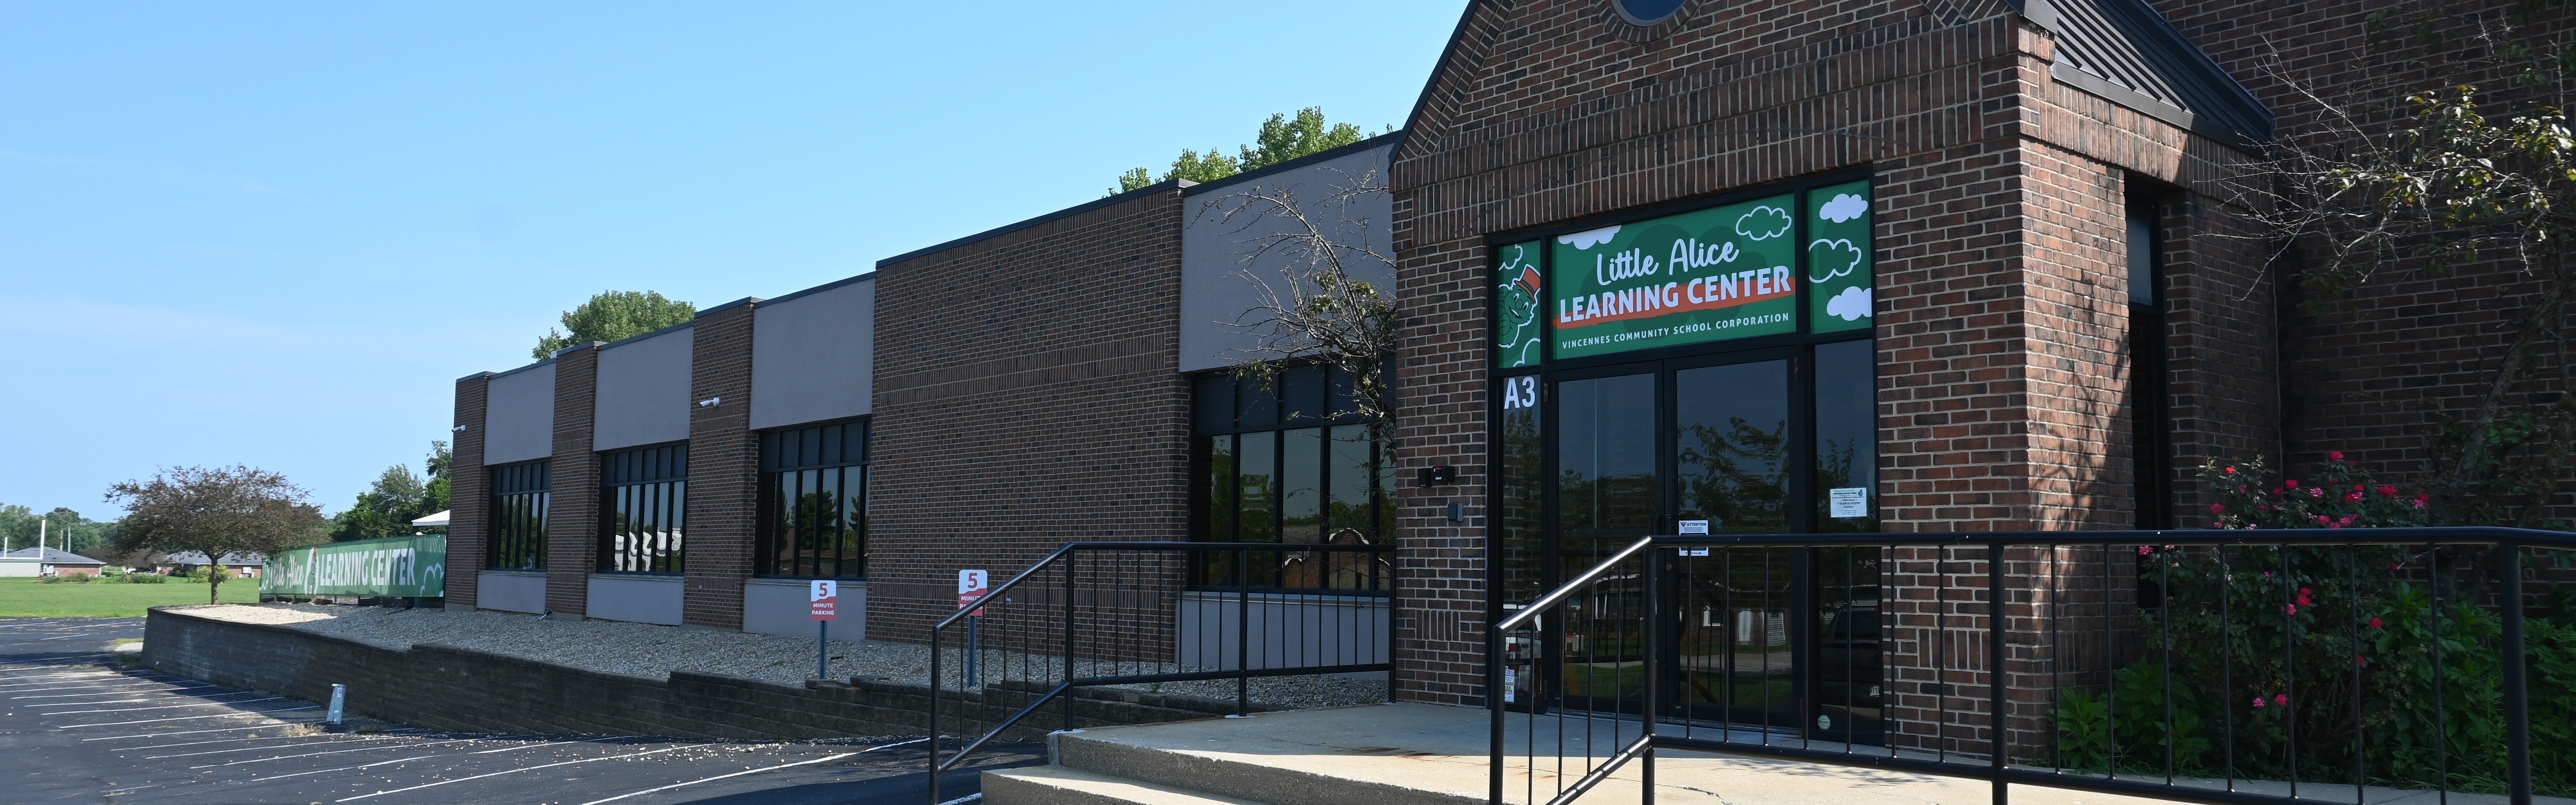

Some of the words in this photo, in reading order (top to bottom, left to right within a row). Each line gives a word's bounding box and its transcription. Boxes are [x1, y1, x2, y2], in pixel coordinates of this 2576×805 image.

[1597, 248, 1659, 285] Little
[1669, 238, 1740, 275] Alice
[1560, 282, 1678, 323] LEARNING
[1687, 266, 1791, 304] CENTER
[1562, 335, 1610, 349] VINCENNES
[1614, 328, 1669, 342] COMMUNITY
[1673, 322, 1711, 334] SCHOOL
[1716, 313, 1789, 329] CORPORATION
[1504, 376, 1535, 409] A3
[286, 554, 304, 589] Alice
[320, 551, 369, 586] LEARNING
[371, 548, 415, 586] CENTER
[967, 573, 977, 588] 5
[819, 583, 827, 596] 5
